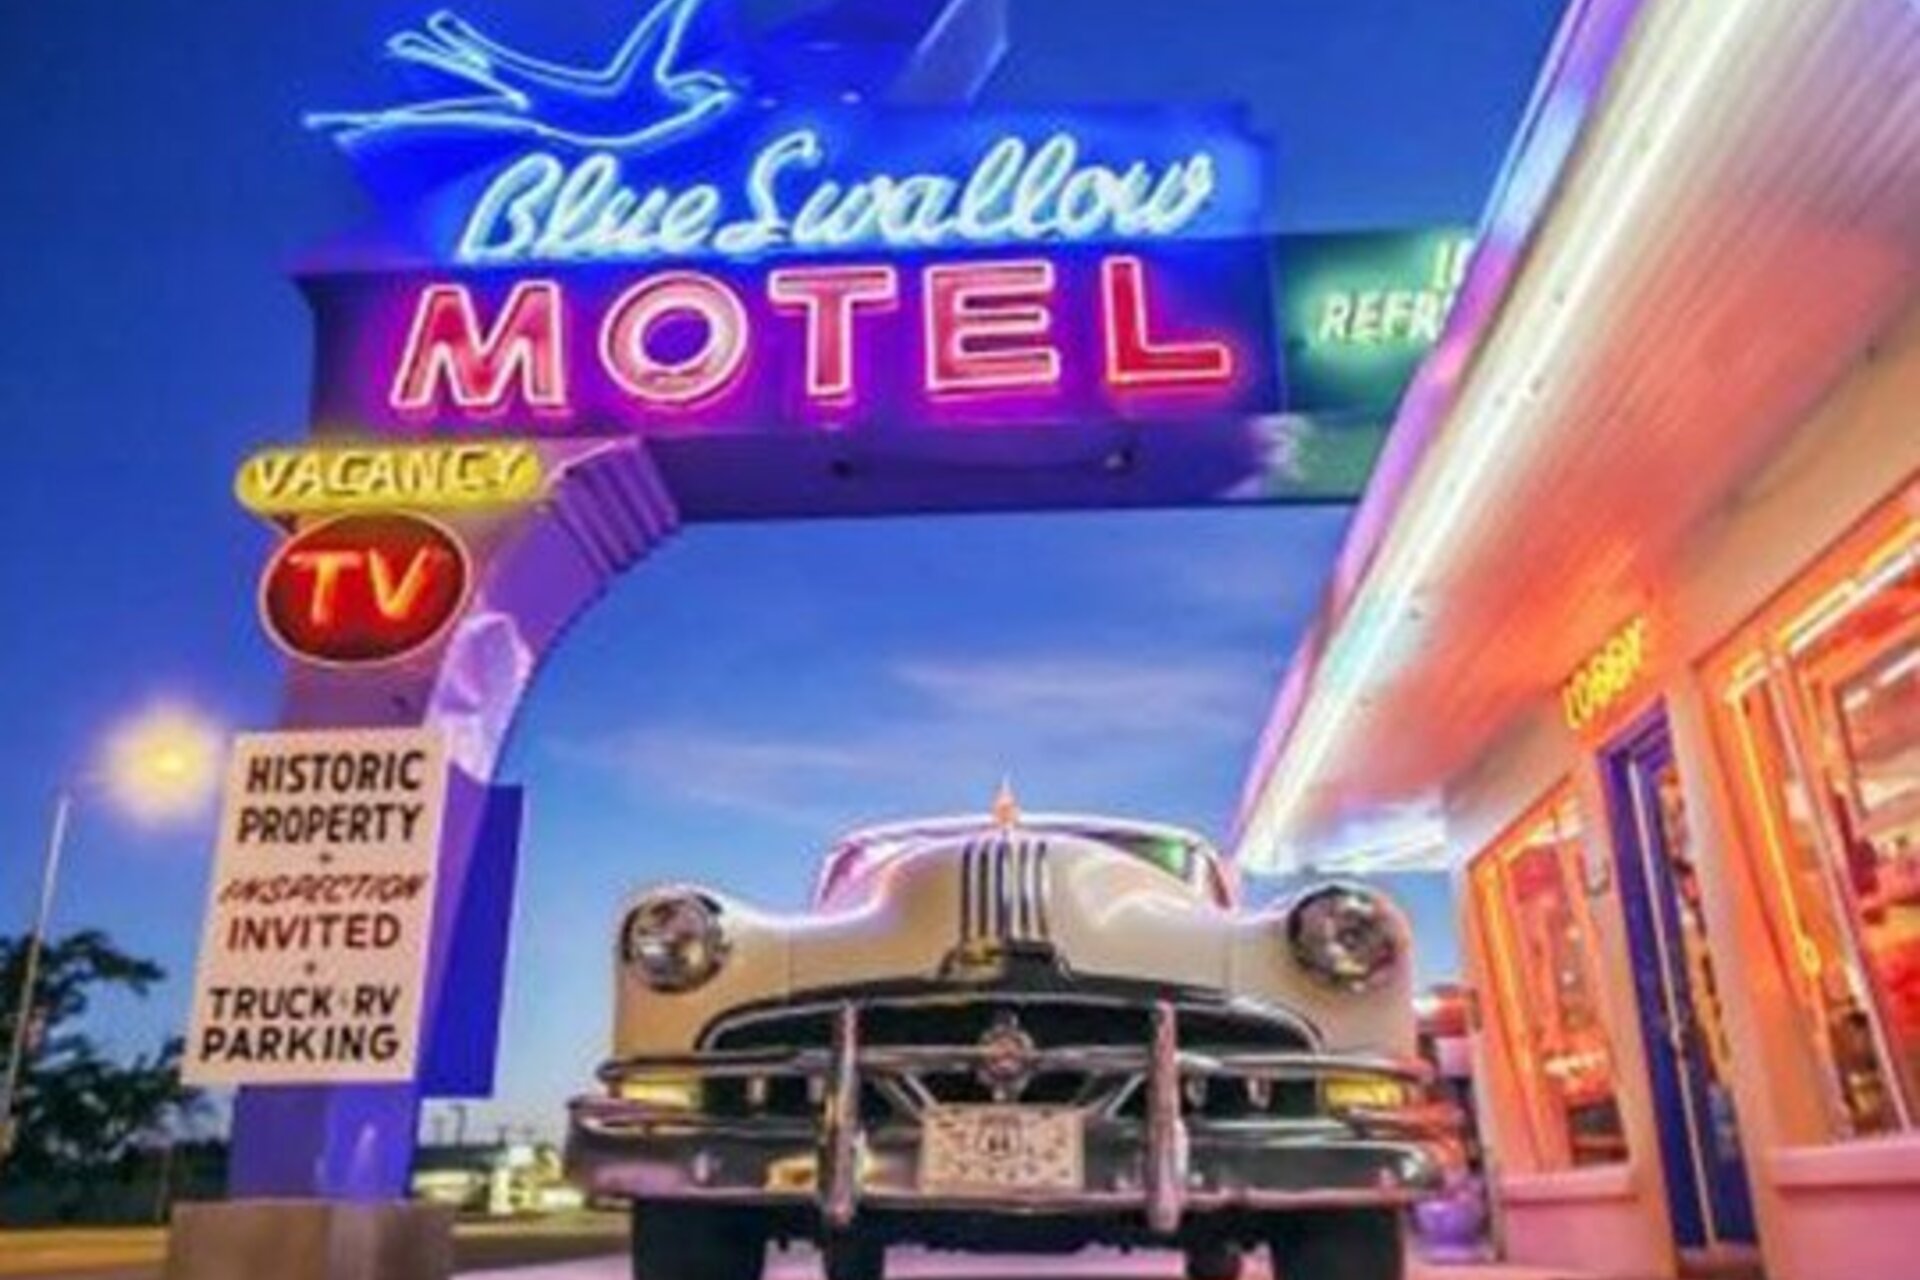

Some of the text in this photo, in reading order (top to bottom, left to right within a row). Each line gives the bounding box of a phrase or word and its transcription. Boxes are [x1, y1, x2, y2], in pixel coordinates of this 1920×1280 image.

[456, 130, 1215, 262] Blue Swallow
[389, 253, 1234, 412] MOTEL
[252, 443, 529, 498] VACANCY
[288, 547, 444, 628] TV
[245, 749, 426, 795] HISTORIC
[236, 803, 424, 845] PROPERTY
[219, 872, 426, 905] INSPECTION
[226, 912, 400, 952] INVITED
[207, 985, 402, 1021] TRUCK RV
[198, 1024, 400, 1063] PARKING
